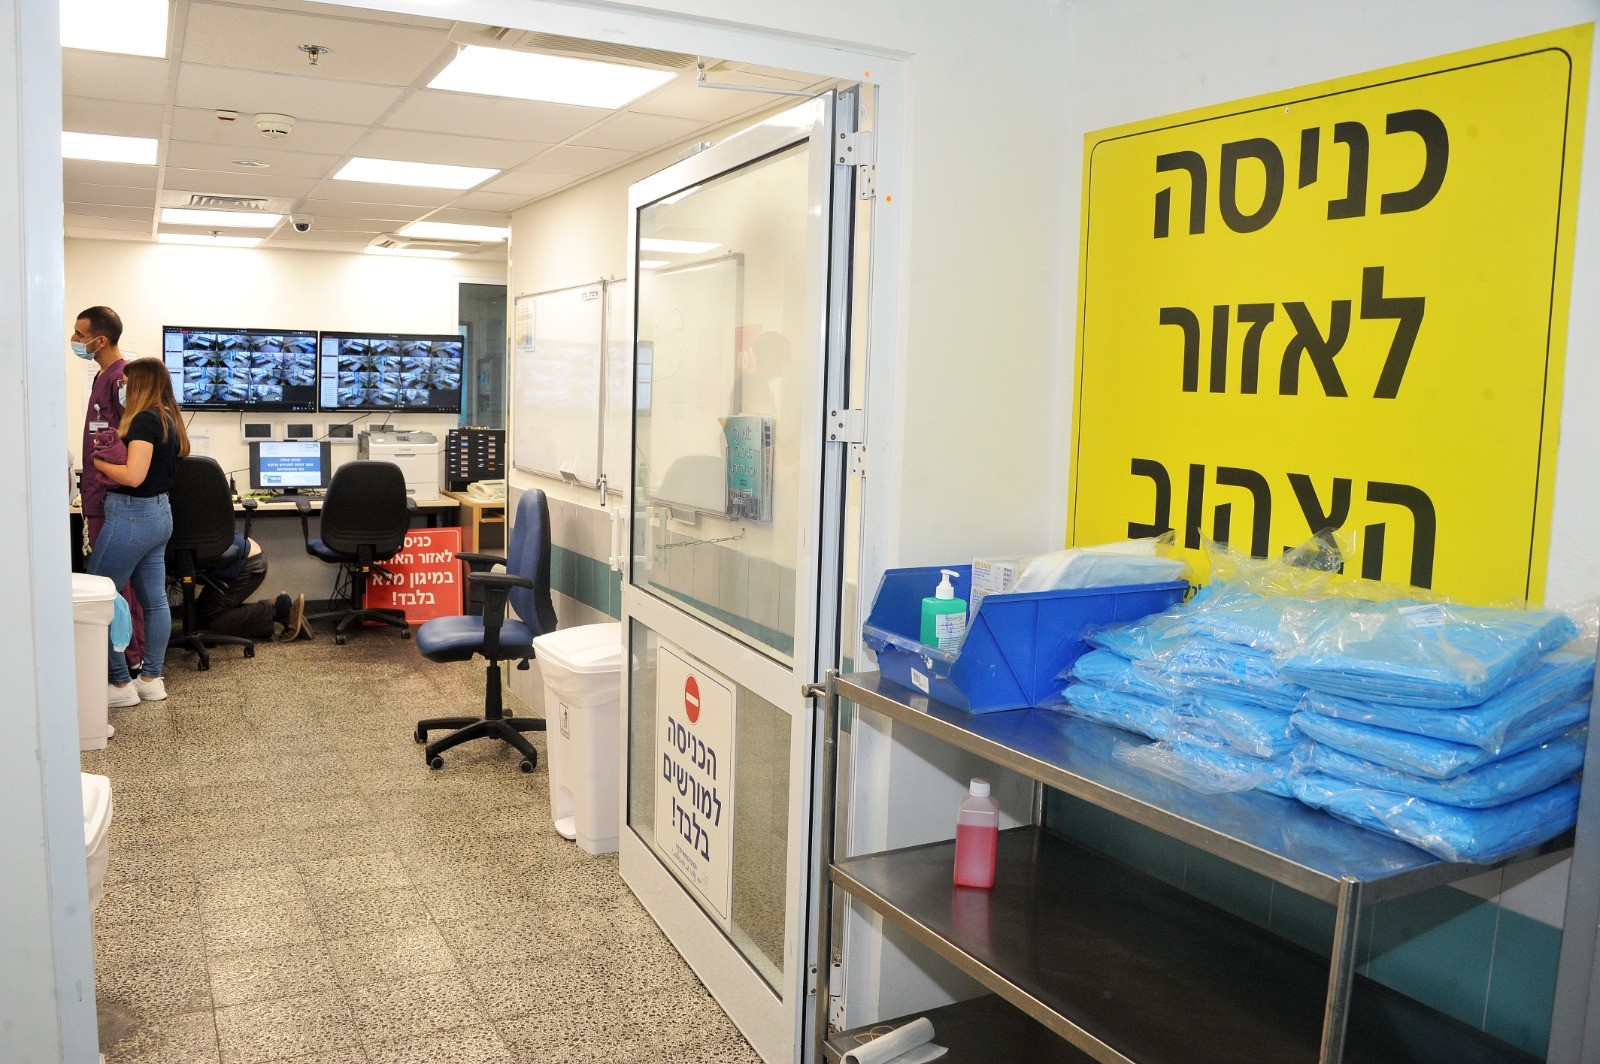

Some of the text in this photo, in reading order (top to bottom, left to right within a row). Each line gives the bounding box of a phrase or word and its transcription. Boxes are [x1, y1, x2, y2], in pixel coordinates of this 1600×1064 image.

[1154, 109, 1449, 239] כניסה
[1160, 266, 1426, 400] לאזור
[402, 536, 431, 548] כניס
[418, 549, 452, 564] לאזור
[1128, 458, 1436, 590] הצהוב
[392, 590, 435, 606] בלבד!
[409, 571, 454, 588] במיגון
[668, 716, 716, 780] הכניסה
[663, 752, 722, 827] למורשים
[672, 796, 709, 862] בלבד!
